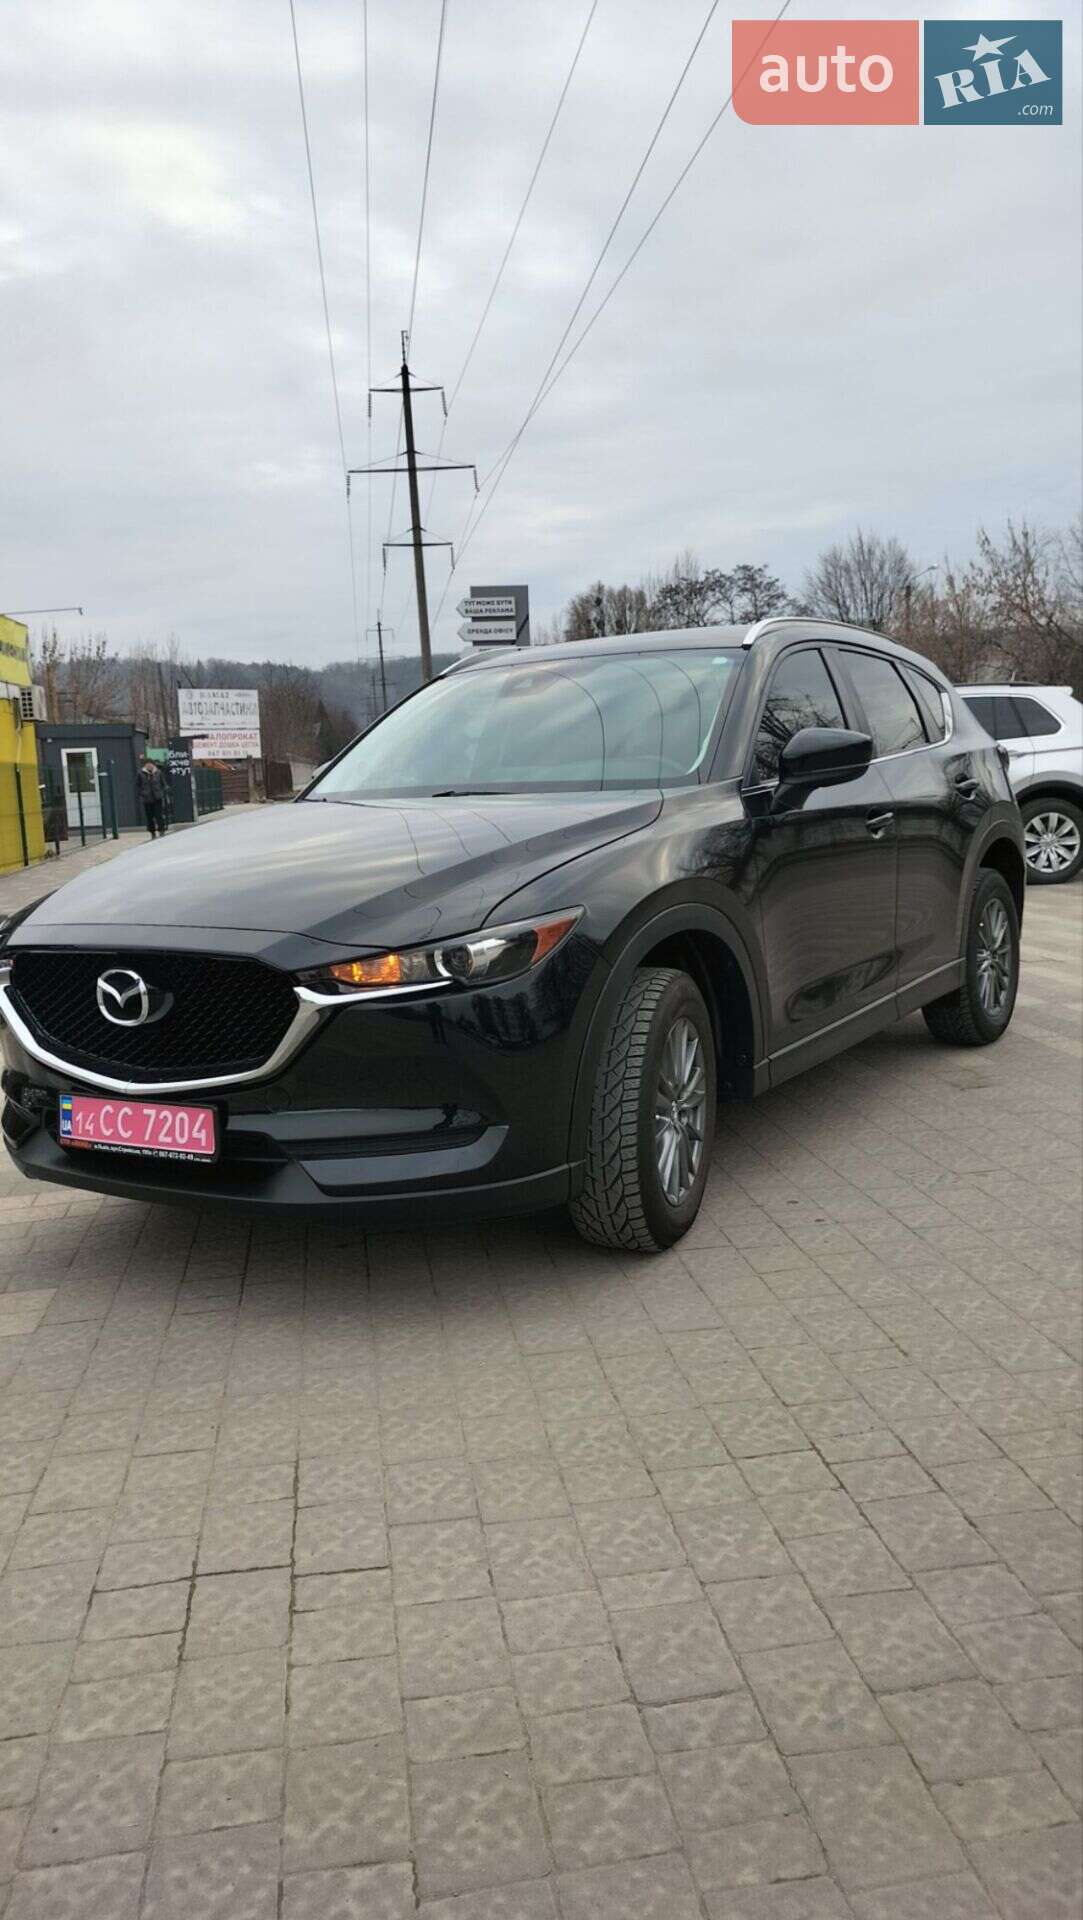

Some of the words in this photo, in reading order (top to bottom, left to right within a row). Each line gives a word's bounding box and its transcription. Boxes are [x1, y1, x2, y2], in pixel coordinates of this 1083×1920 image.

[62, 1120, 72, 1132] UA
[75, 1111, 96, 1135] 14
[99, 1104, 134, 1139] CC
[143, 1108, 207, 1147] 7204
